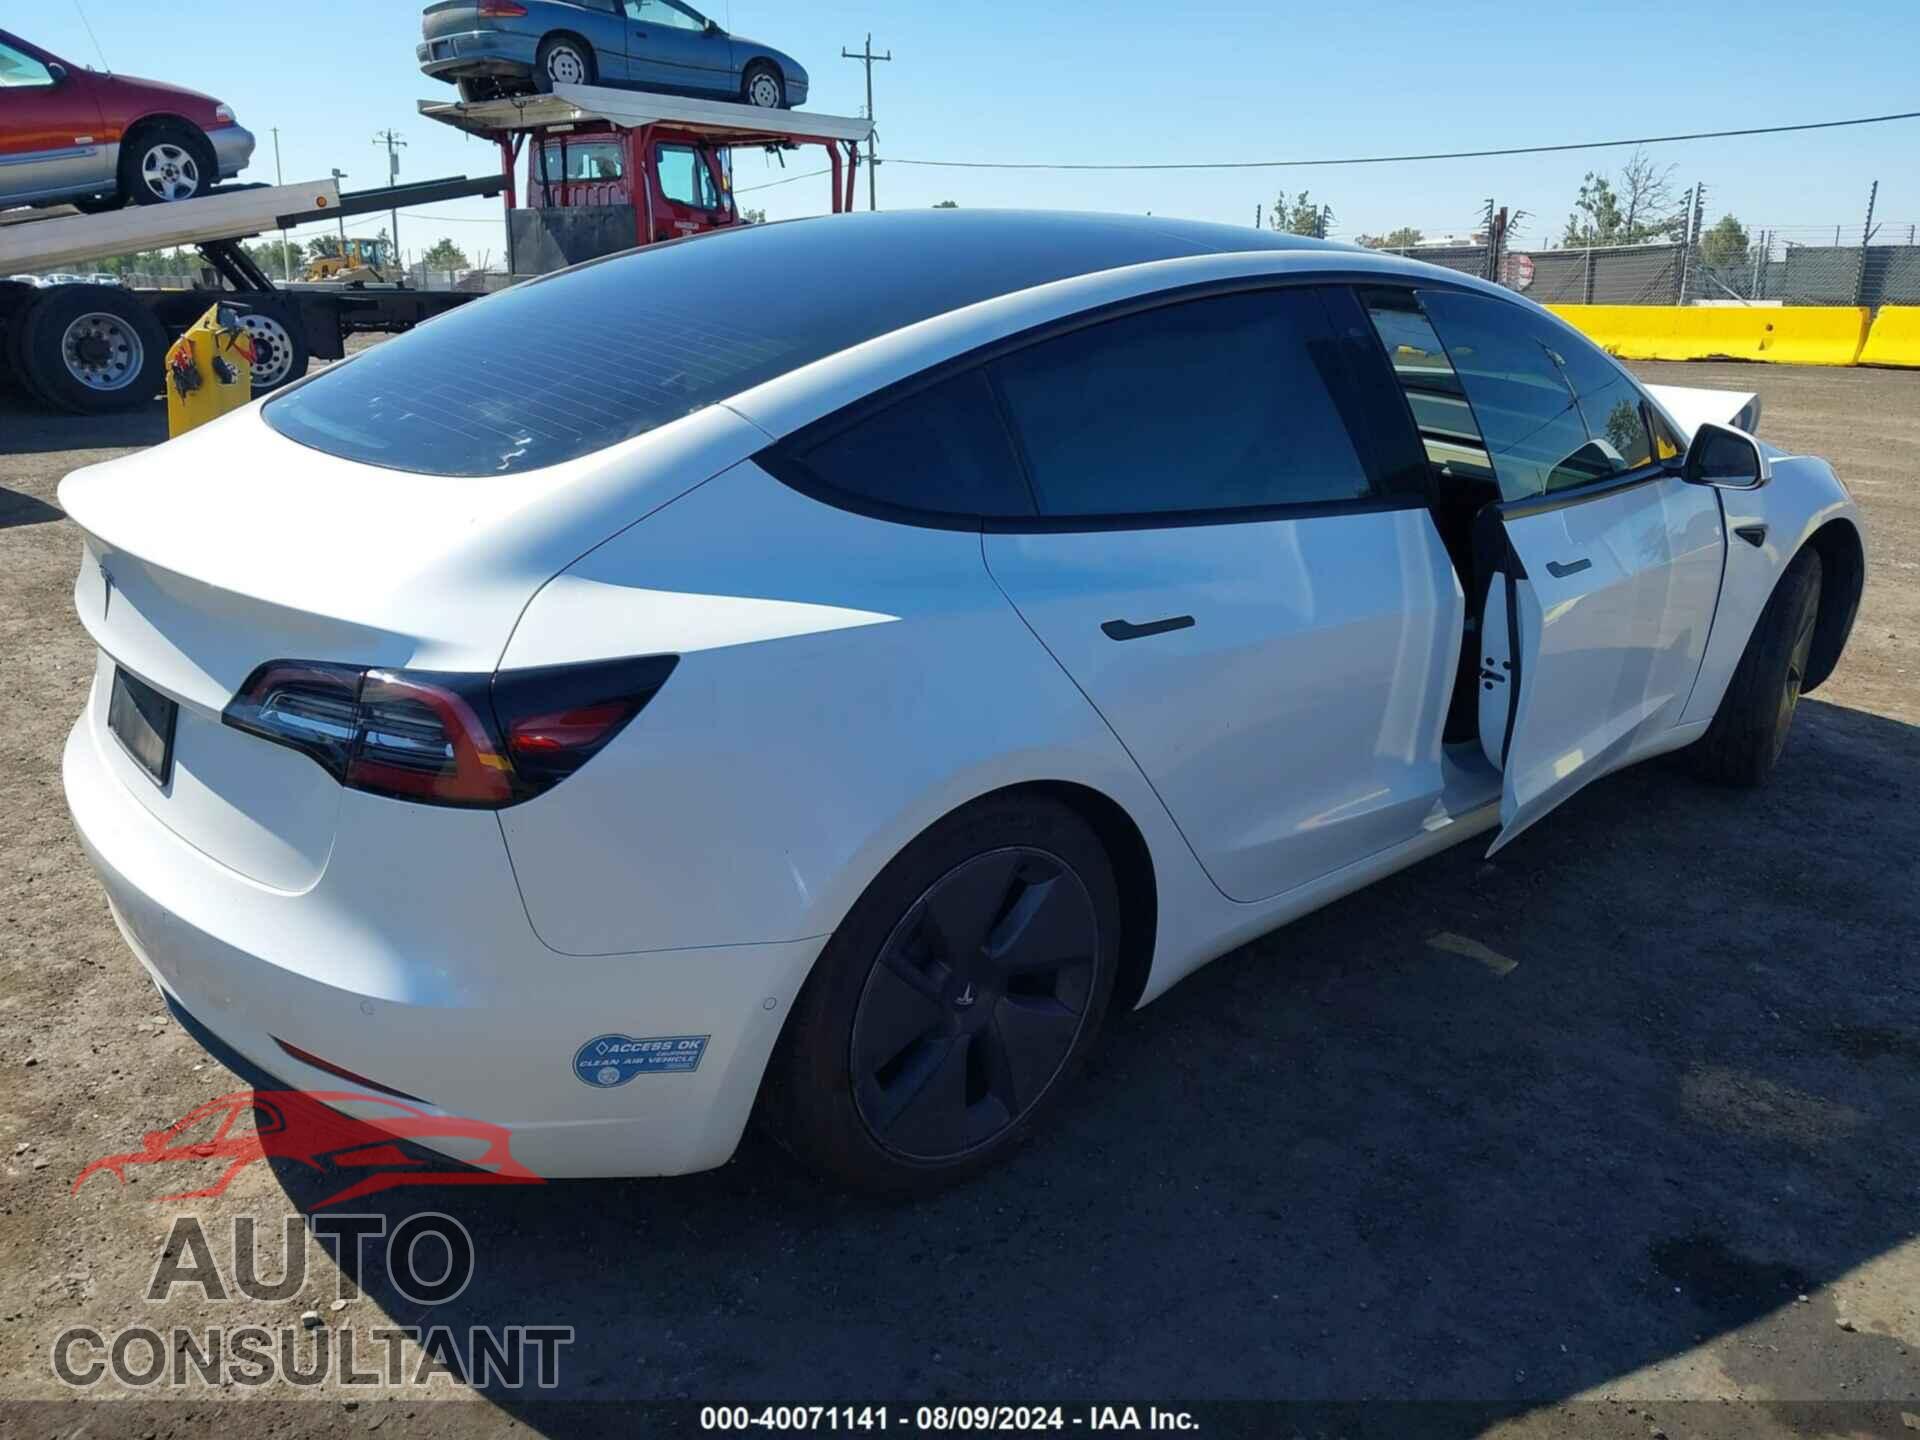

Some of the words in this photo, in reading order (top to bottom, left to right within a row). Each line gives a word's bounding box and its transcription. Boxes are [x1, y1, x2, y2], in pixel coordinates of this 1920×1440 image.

[608, 1041, 672, 1053] ACCESS
[678, 1040, 701, 1050] OK
[579, 1058, 620, 1067] CLEAN
[623, 1057, 644, 1065] AIR
[648, 1055, 697, 1064] VEHICLE
